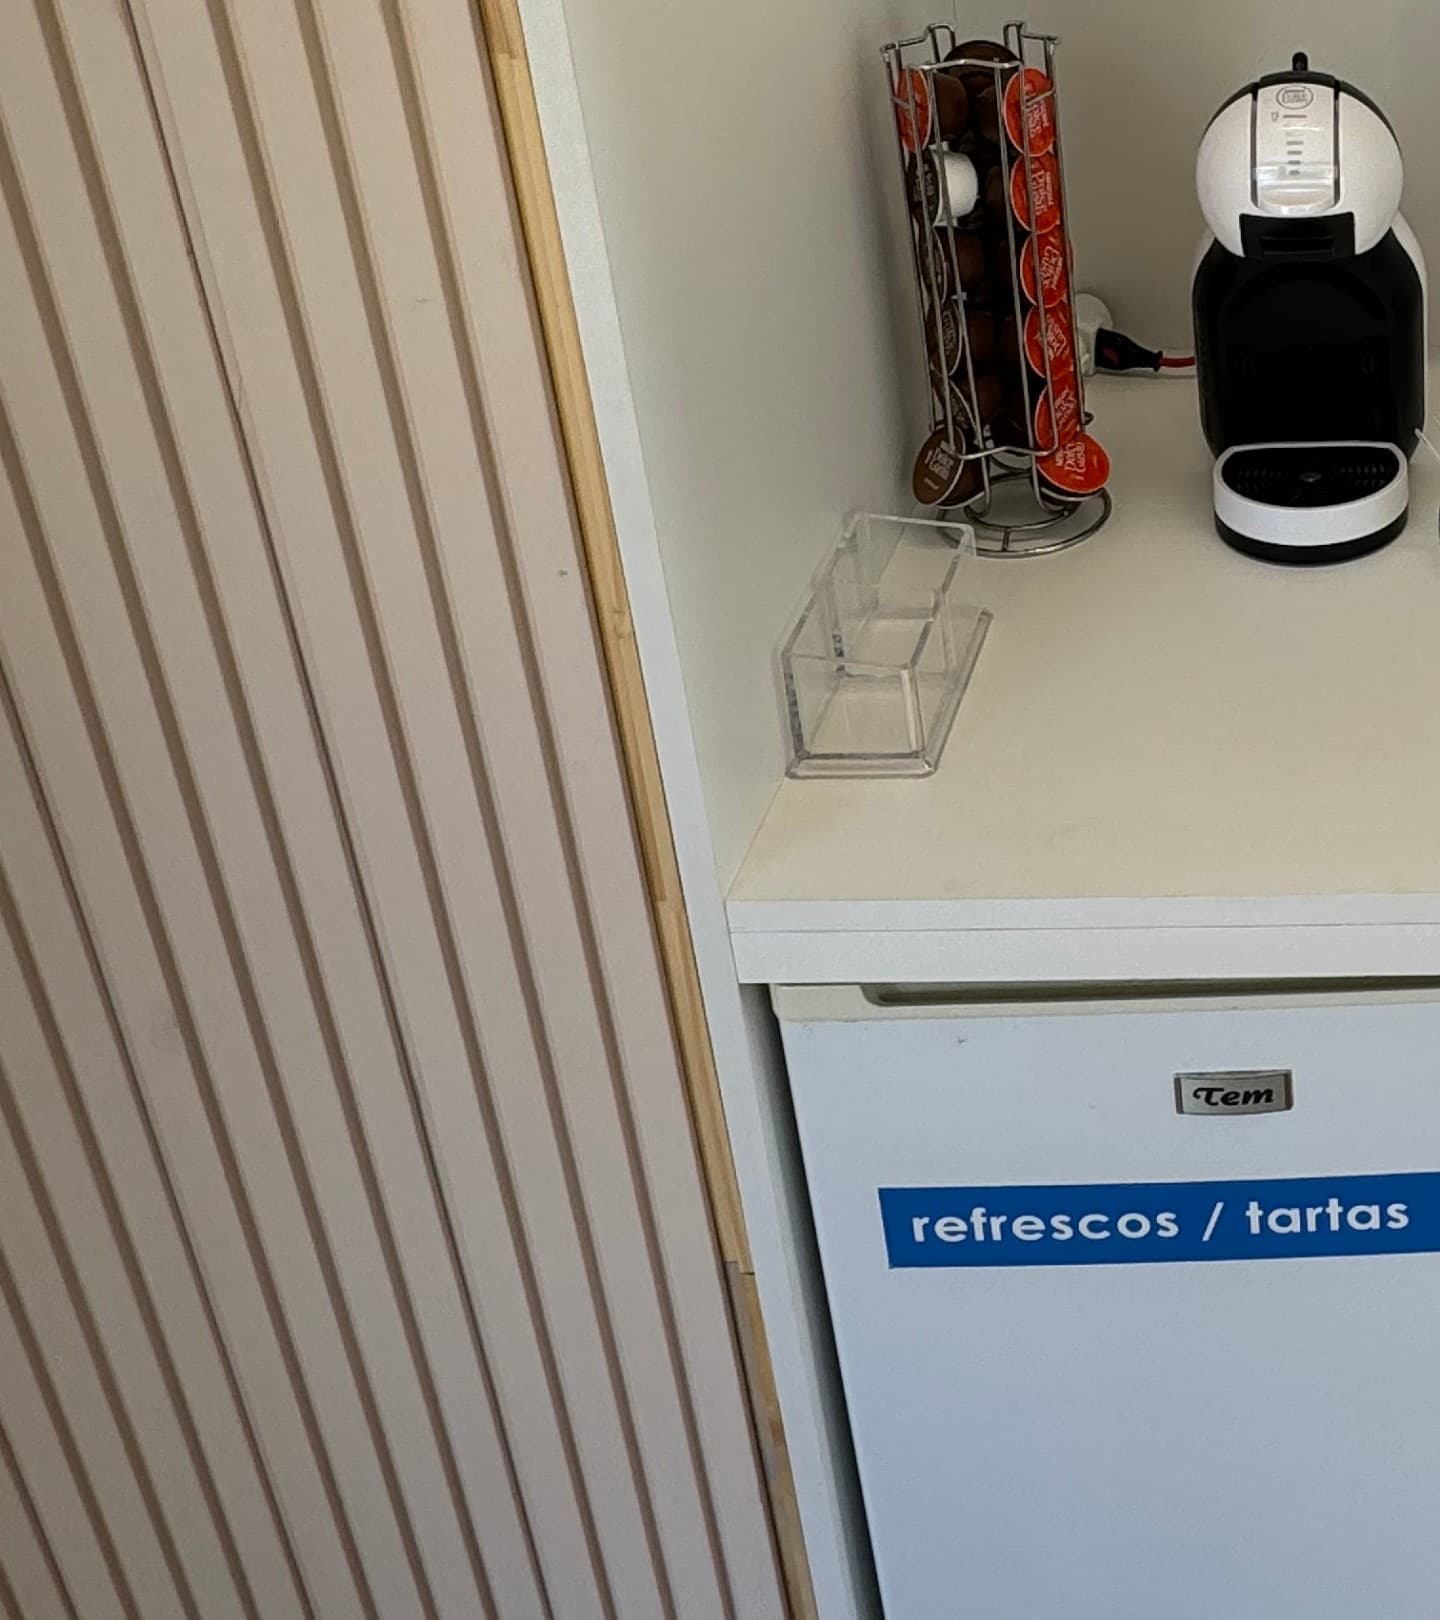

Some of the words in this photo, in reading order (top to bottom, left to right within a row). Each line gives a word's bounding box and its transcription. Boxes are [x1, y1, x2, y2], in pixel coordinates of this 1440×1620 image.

[1192, 1087, 1274, 1106] Tem
[912, 1207, 1179, 1242] refrescos
[1245, 1197, 1410, 1234] tartas
